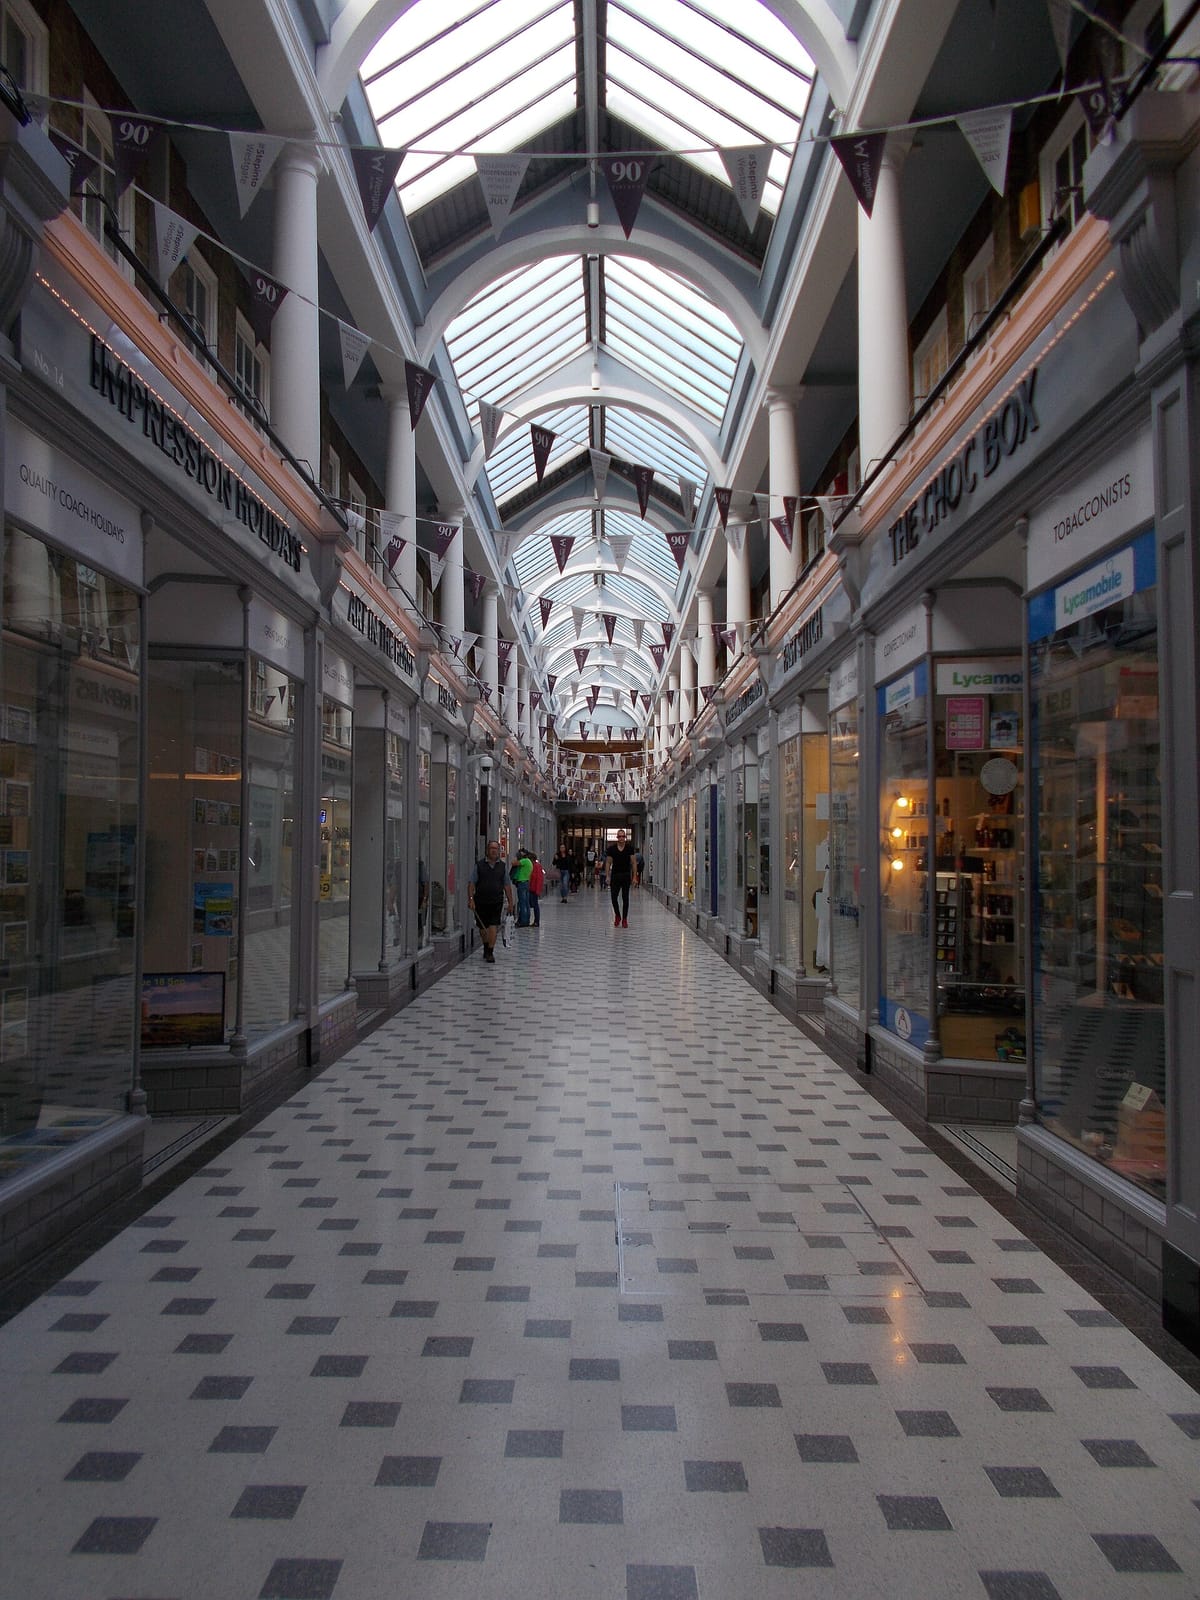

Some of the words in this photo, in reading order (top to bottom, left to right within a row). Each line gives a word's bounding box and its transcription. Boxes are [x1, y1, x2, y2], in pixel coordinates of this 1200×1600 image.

[90, 334, 232, 510] IMPRESSION
[234, 476, 303, 573] HOLIDAYS
[888, 501, 920, 566] THE
[921, 437, 978, 534] CHOC
[983, 367, 1040, 478] BOX
[19, 464, 58, 501] QUALITY
[59, 489, 90, 519] COACH
[90, 509, 125, 544] HOLIDAYS
[1053, 474, 1132, 544] TOBACCONISTS
[347, 592, 366, 635] ART
[1063, 571, 1122, 615] Lycamobile
